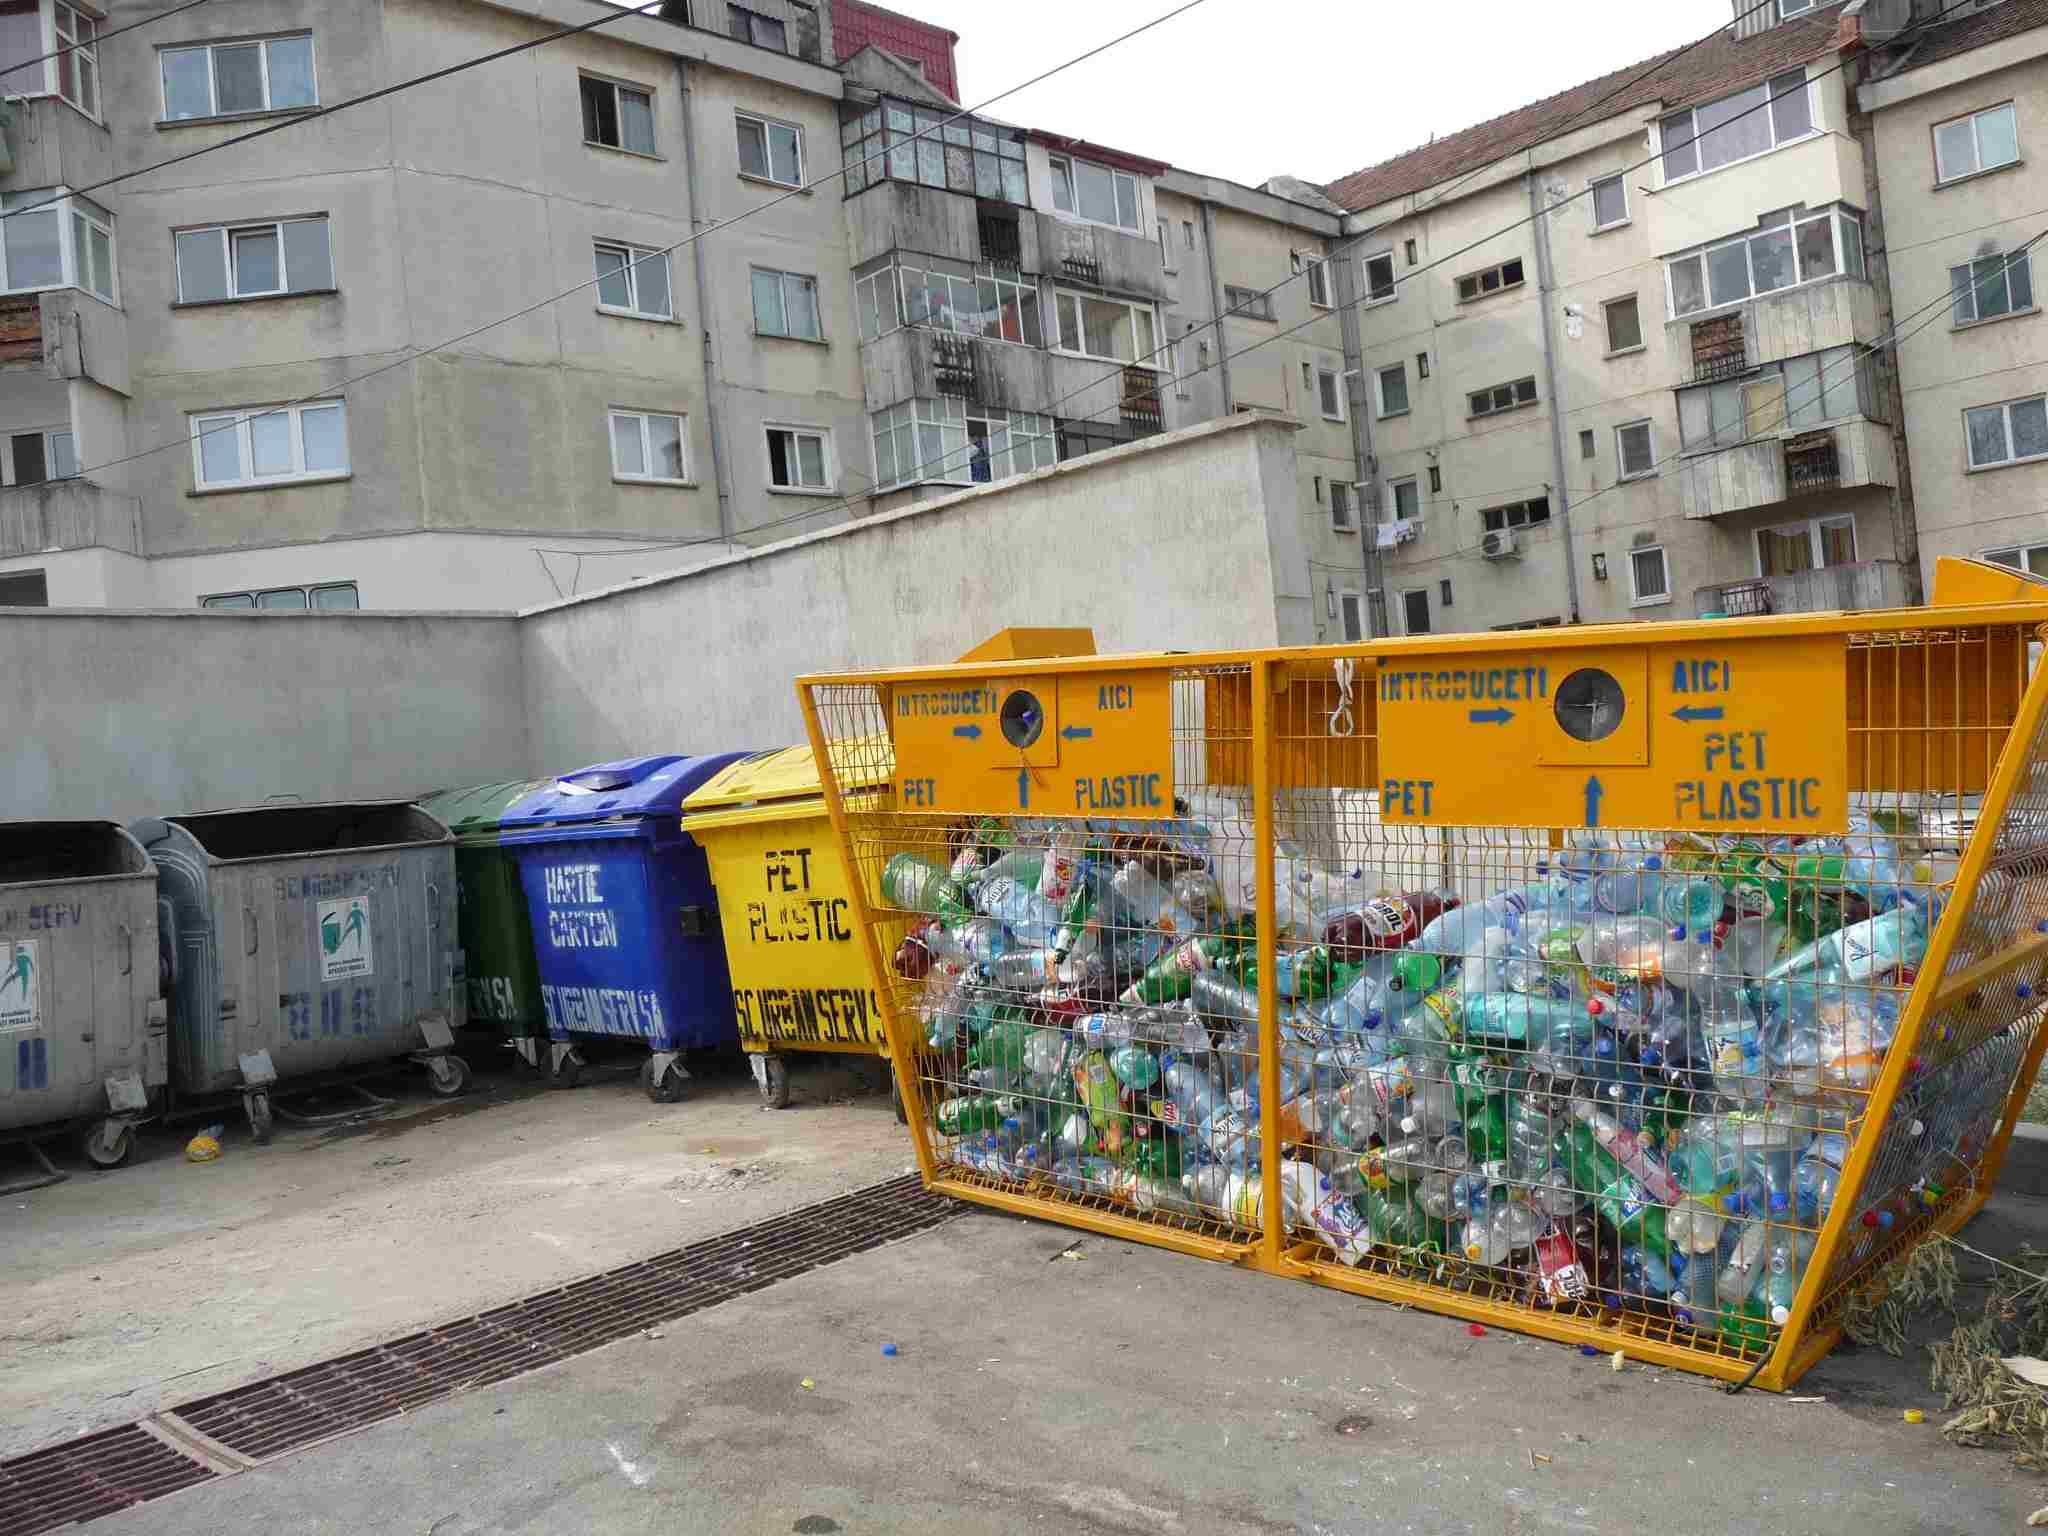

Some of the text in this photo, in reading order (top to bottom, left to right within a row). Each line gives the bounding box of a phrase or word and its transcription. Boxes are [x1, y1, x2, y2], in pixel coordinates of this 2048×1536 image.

[1380, 666, 1548, 702] INTRODUCETI
[1672, 659, 1731, 693] AICI
[897, 687, 997, 717] INTRODUCETI
[1098, 684, 1133, 711] AICI
[1704, 731, 1767, 771] PET
[903, 778, 936, 807] PET
[1075, 773, 1162, 809] PLASTIC
[1383, 779, 1435, 817] PET
[1675, 777, 1822, 821] PLASTIC
[544, 863, 604, 905] HARTIE
[765, 847, 812, 893] PET
[549, 909, 618, 948] CARTON
[746, 898, 852, 942] PLASTIC
[869, 989, 888, 1047] S
